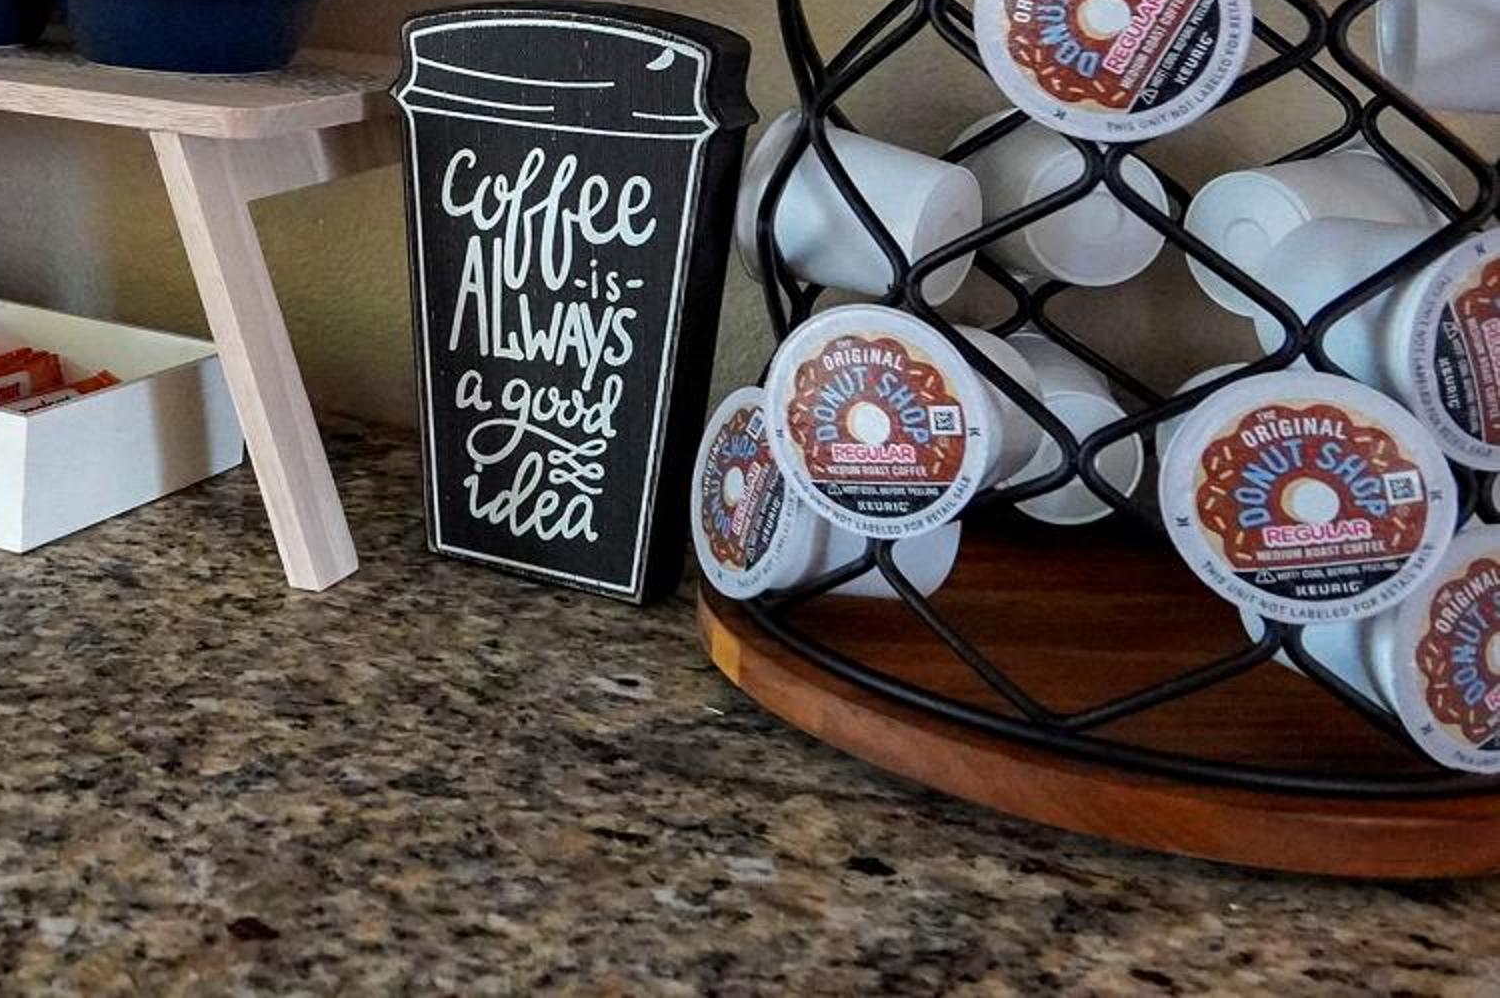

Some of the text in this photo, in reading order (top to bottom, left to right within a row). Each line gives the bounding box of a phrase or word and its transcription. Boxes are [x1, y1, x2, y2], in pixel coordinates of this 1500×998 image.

[1173, 30, 1214, 86] KEURIG
[441, 147, 657, 292] Coffee
[448, 235, 638, 391] ALWAYS
[822, 349, 904, 372] ORIGINAL
[1438, 357, 1460, 410] KEURIG
[456, 369, 622, 465] a good
[814, 366, 930, 444] DONUT SHOP
[1256, 409, 1277, 421] THE
[830, 442, 916, 463] REGULAR
[1240, 417, 1348, 448] ORIGINAL
[463, 451, 599, 543] idea
[856, 501, 909, 512] KEURIG
[1234, 439, 1388, 529] DONUT SHOP
[761, 500, 781, 545] KEURIG
[1262, 519, 1373, 548] REGULAR
[1295, 582, 1362, 597] KEURIG
[1434, 568, 1500, 635] ORIGINAL
[1452, 603, 1490, 706] DONUT
